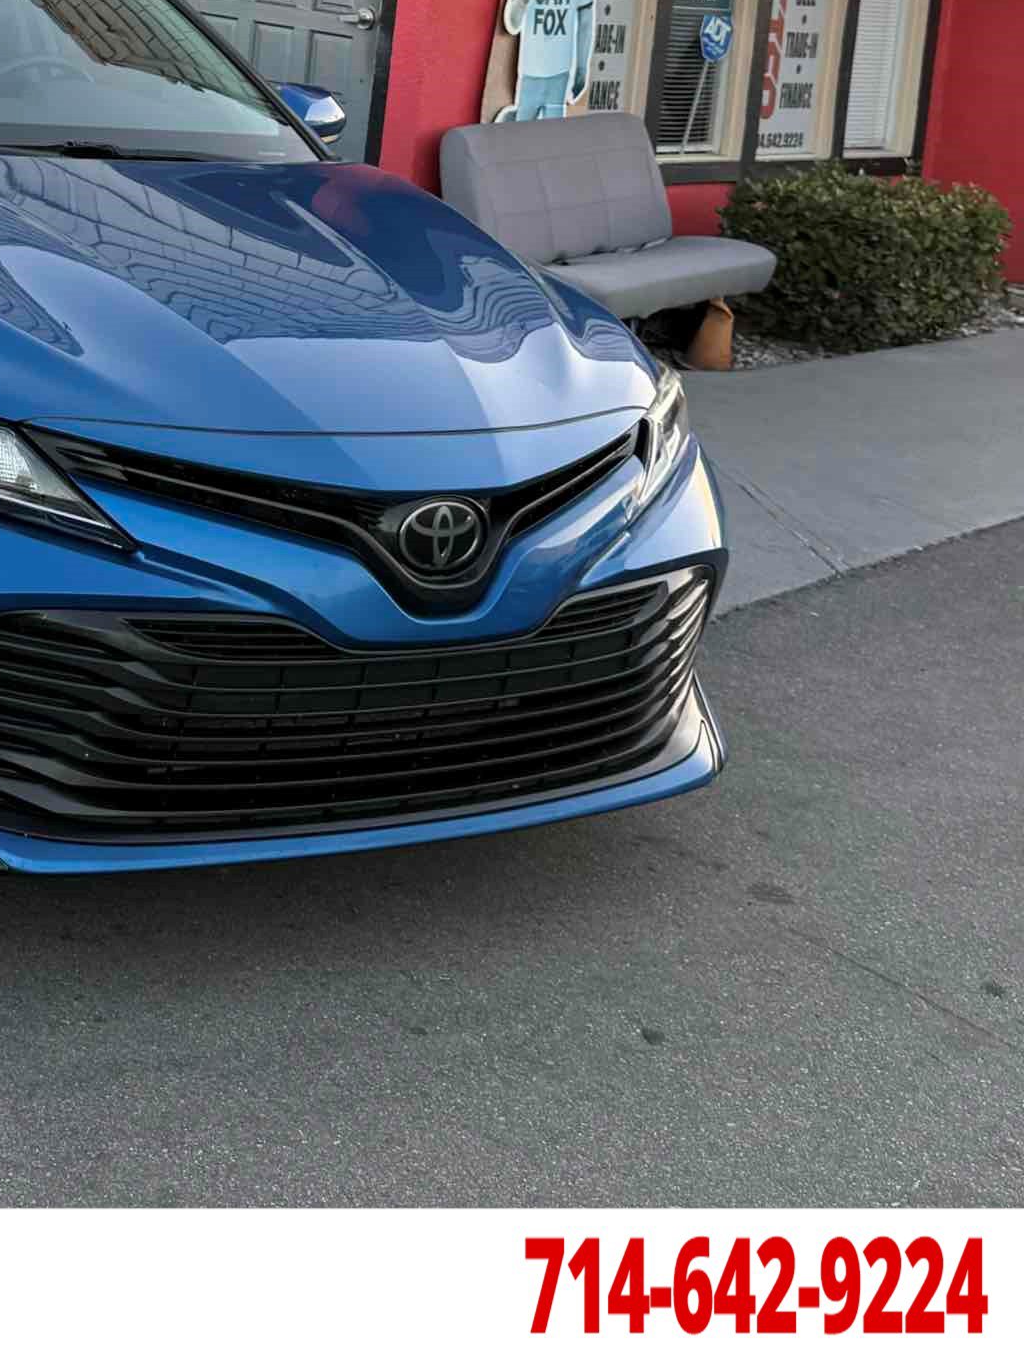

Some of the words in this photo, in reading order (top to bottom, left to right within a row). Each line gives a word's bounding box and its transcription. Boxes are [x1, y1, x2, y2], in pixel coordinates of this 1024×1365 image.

[533, 7, 568, 36] FOX
[703, 15, 731, 46] ADT
[594, 24, 626, 54] ADE-IN
[779, 82, 813, 109] FINANCE
